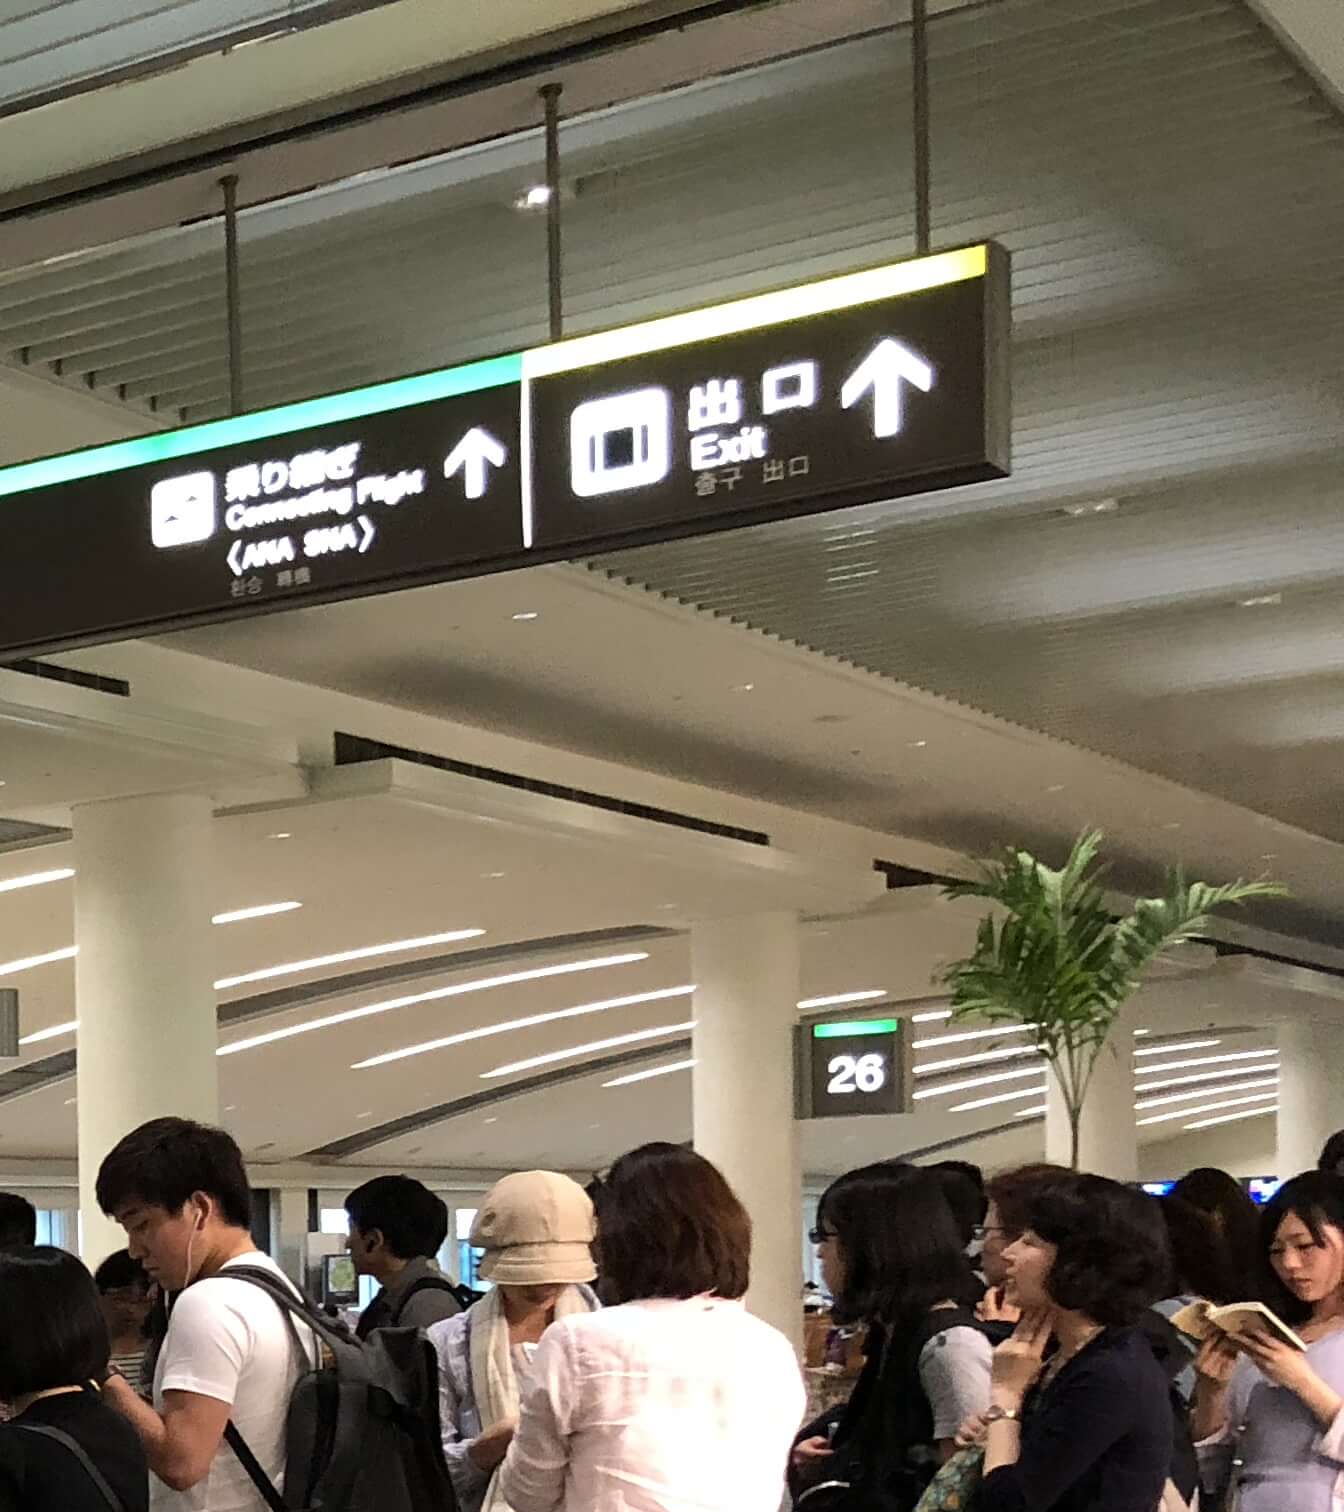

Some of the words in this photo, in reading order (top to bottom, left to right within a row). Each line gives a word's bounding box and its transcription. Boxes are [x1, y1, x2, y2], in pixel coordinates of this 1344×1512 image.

[688, 361, 815, 433] 出口
[690, 426, 768, 471] Exit
[762, 455, 810, 484] 出口
[224, 486, 354, 531] Connecting
[356, 469, 426, 505] Flight
[827, 1053, 885, 1094] 26
